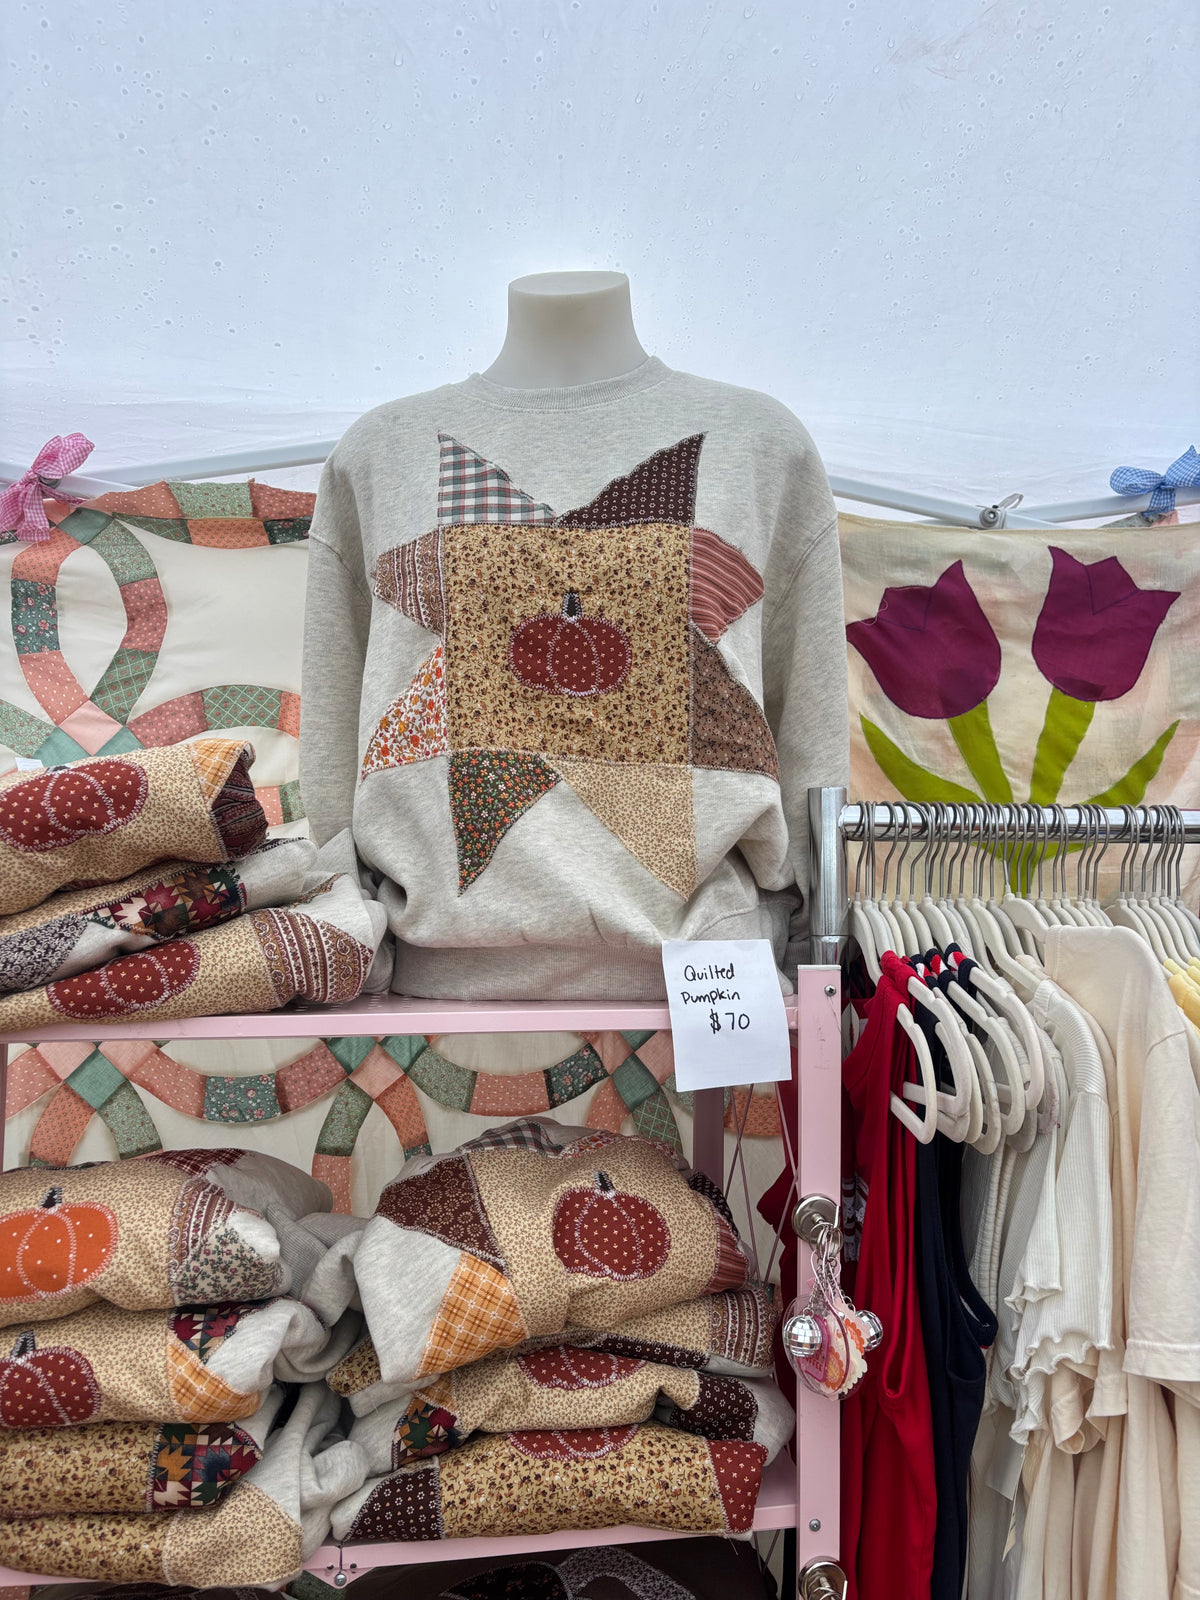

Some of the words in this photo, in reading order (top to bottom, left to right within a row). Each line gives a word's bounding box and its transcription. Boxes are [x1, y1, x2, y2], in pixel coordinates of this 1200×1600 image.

[684, 962, 735, 981] Quilted
[681, 988, 740, 1005] Pumpkin
[710, 1008, 750, 1034] $70
